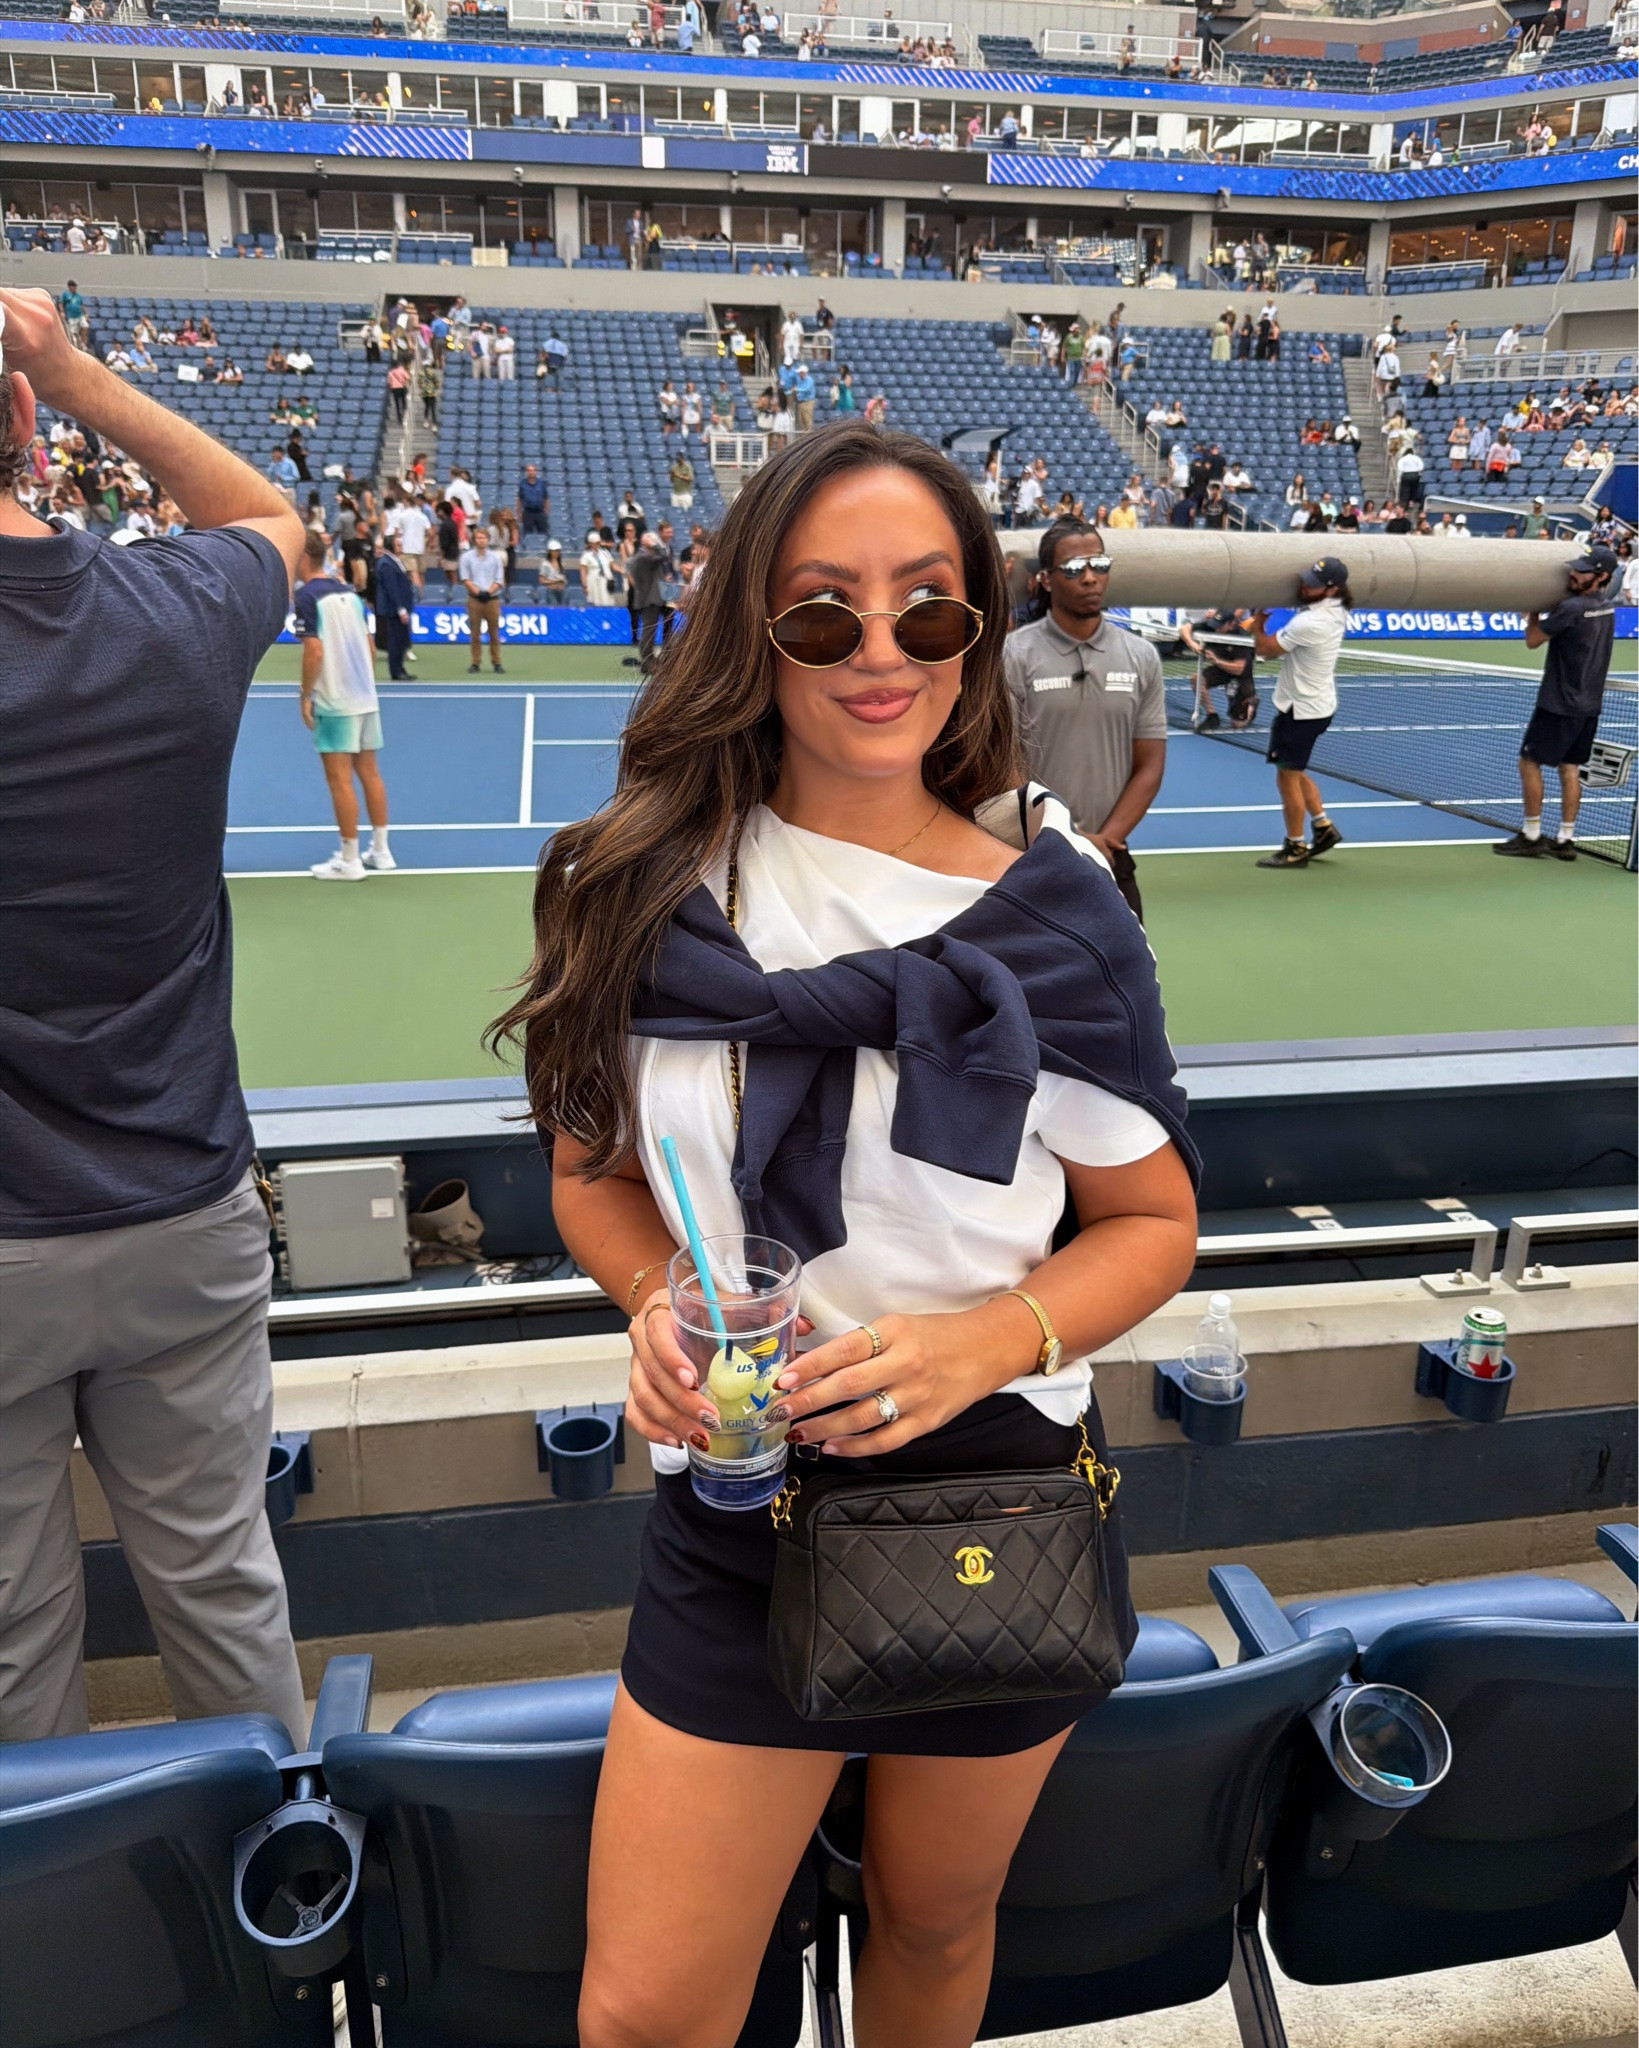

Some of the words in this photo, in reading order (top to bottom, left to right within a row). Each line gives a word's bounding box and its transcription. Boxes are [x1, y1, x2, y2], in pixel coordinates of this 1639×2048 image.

[767, 155, 799, 172] IBM
[1386, 612, 1485, 632] DOUBLES
[1033, 676, 1072, 692] SECURITY
[736, 1363, 754, 1373] us
[726, 1418, 754, 1428] GREY
